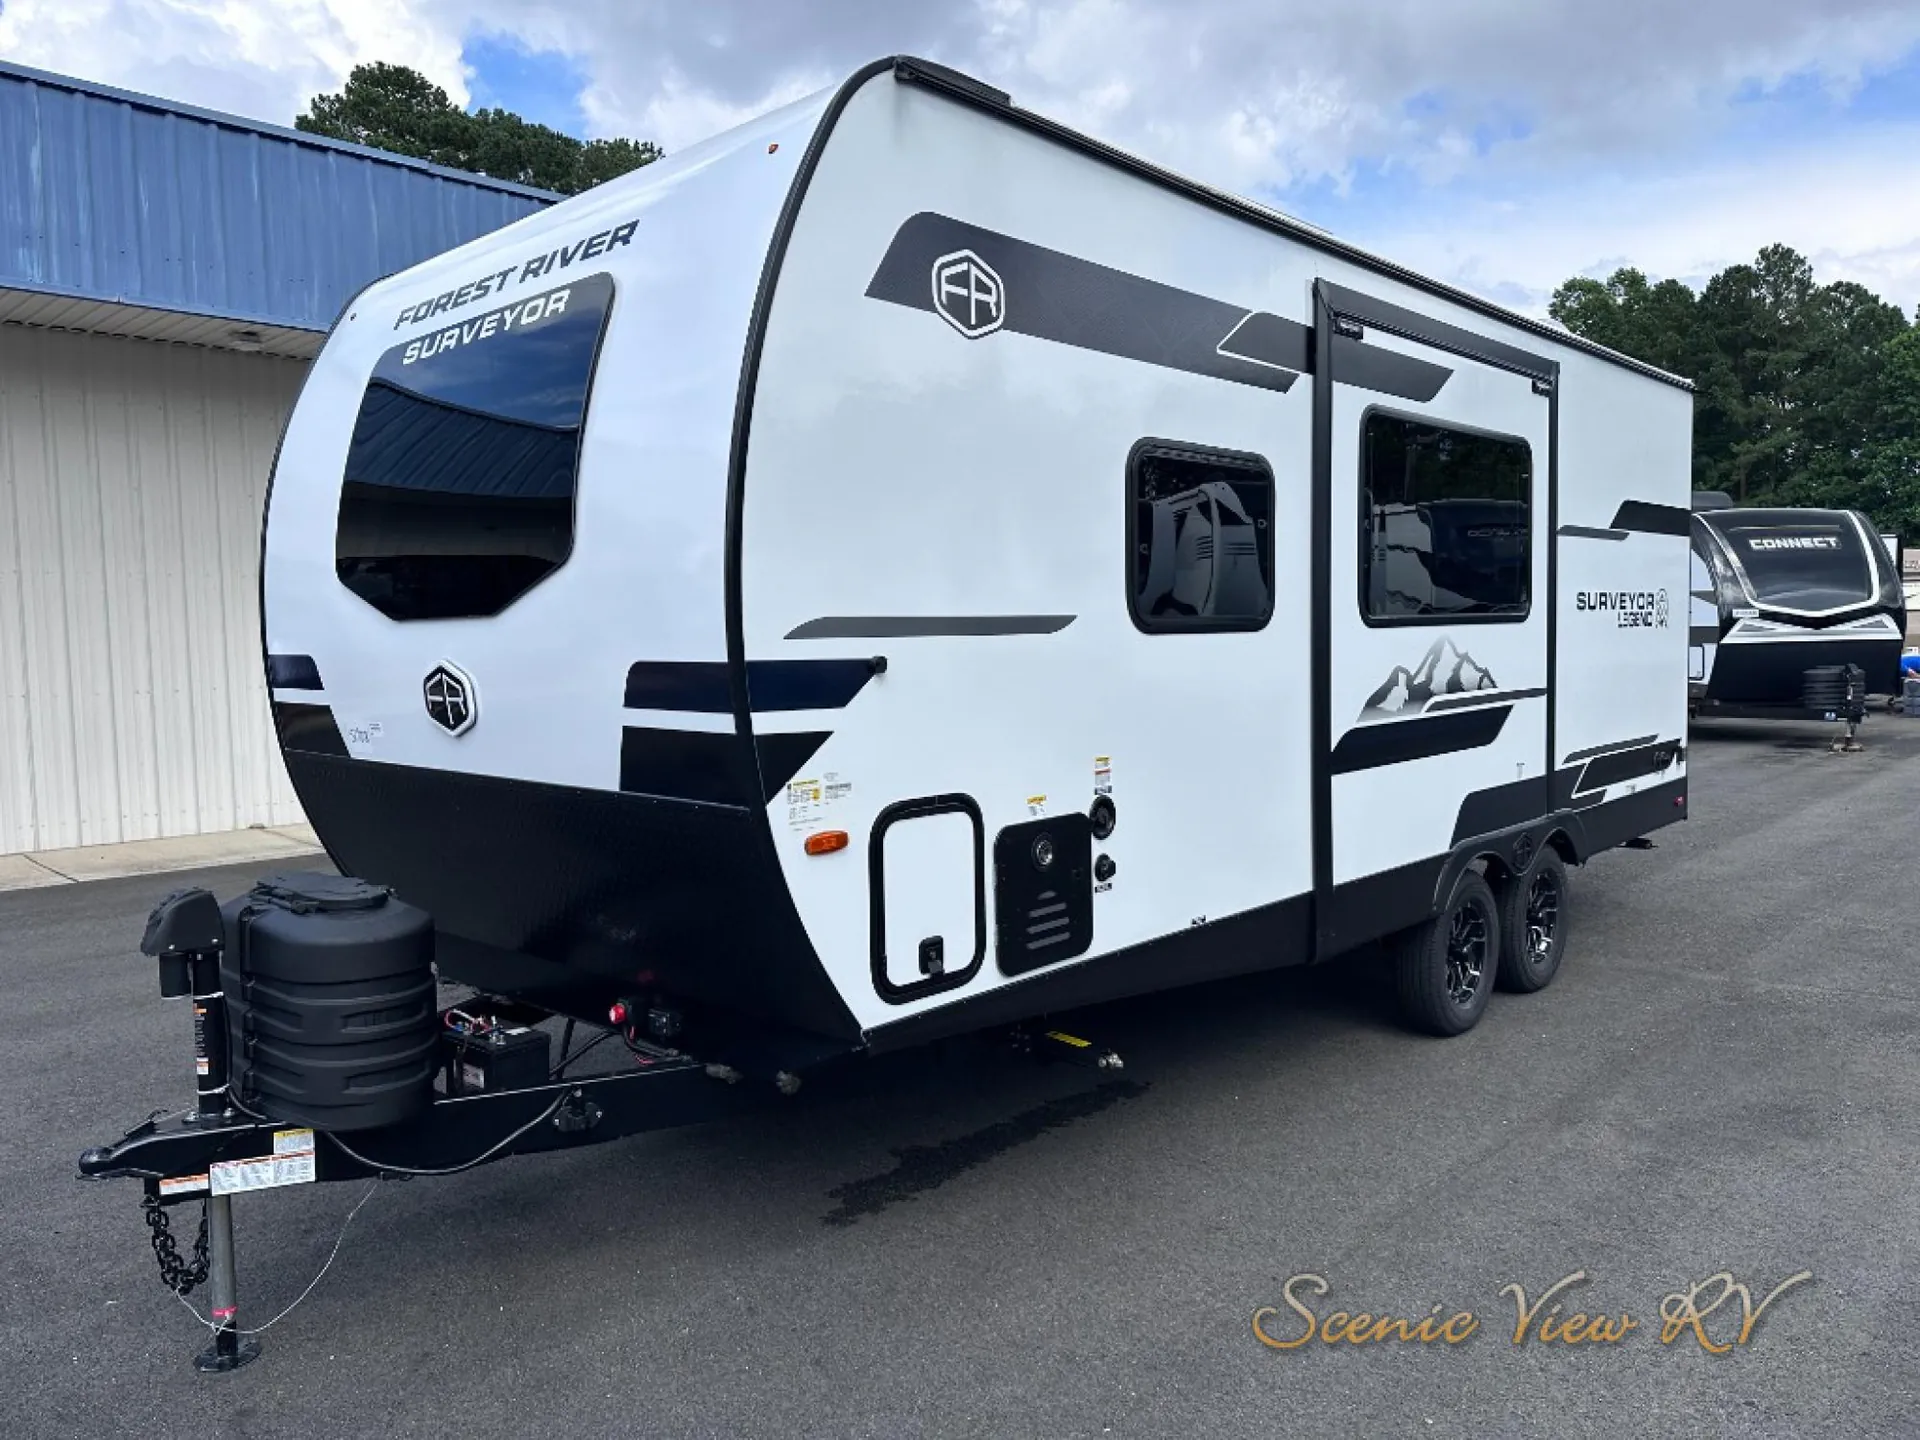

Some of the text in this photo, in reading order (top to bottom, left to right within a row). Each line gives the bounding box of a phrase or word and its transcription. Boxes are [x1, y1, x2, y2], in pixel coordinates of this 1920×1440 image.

[393, 219, 640, 331] FOREST RIVER
[402, 289, 571, 365] SURVEYOR
[1748, 537, 1838, 550] CONNECT
[1576, 591, 1655, 610] SURVEYOR
[1617, 611, 1653, 628] LEGEND
